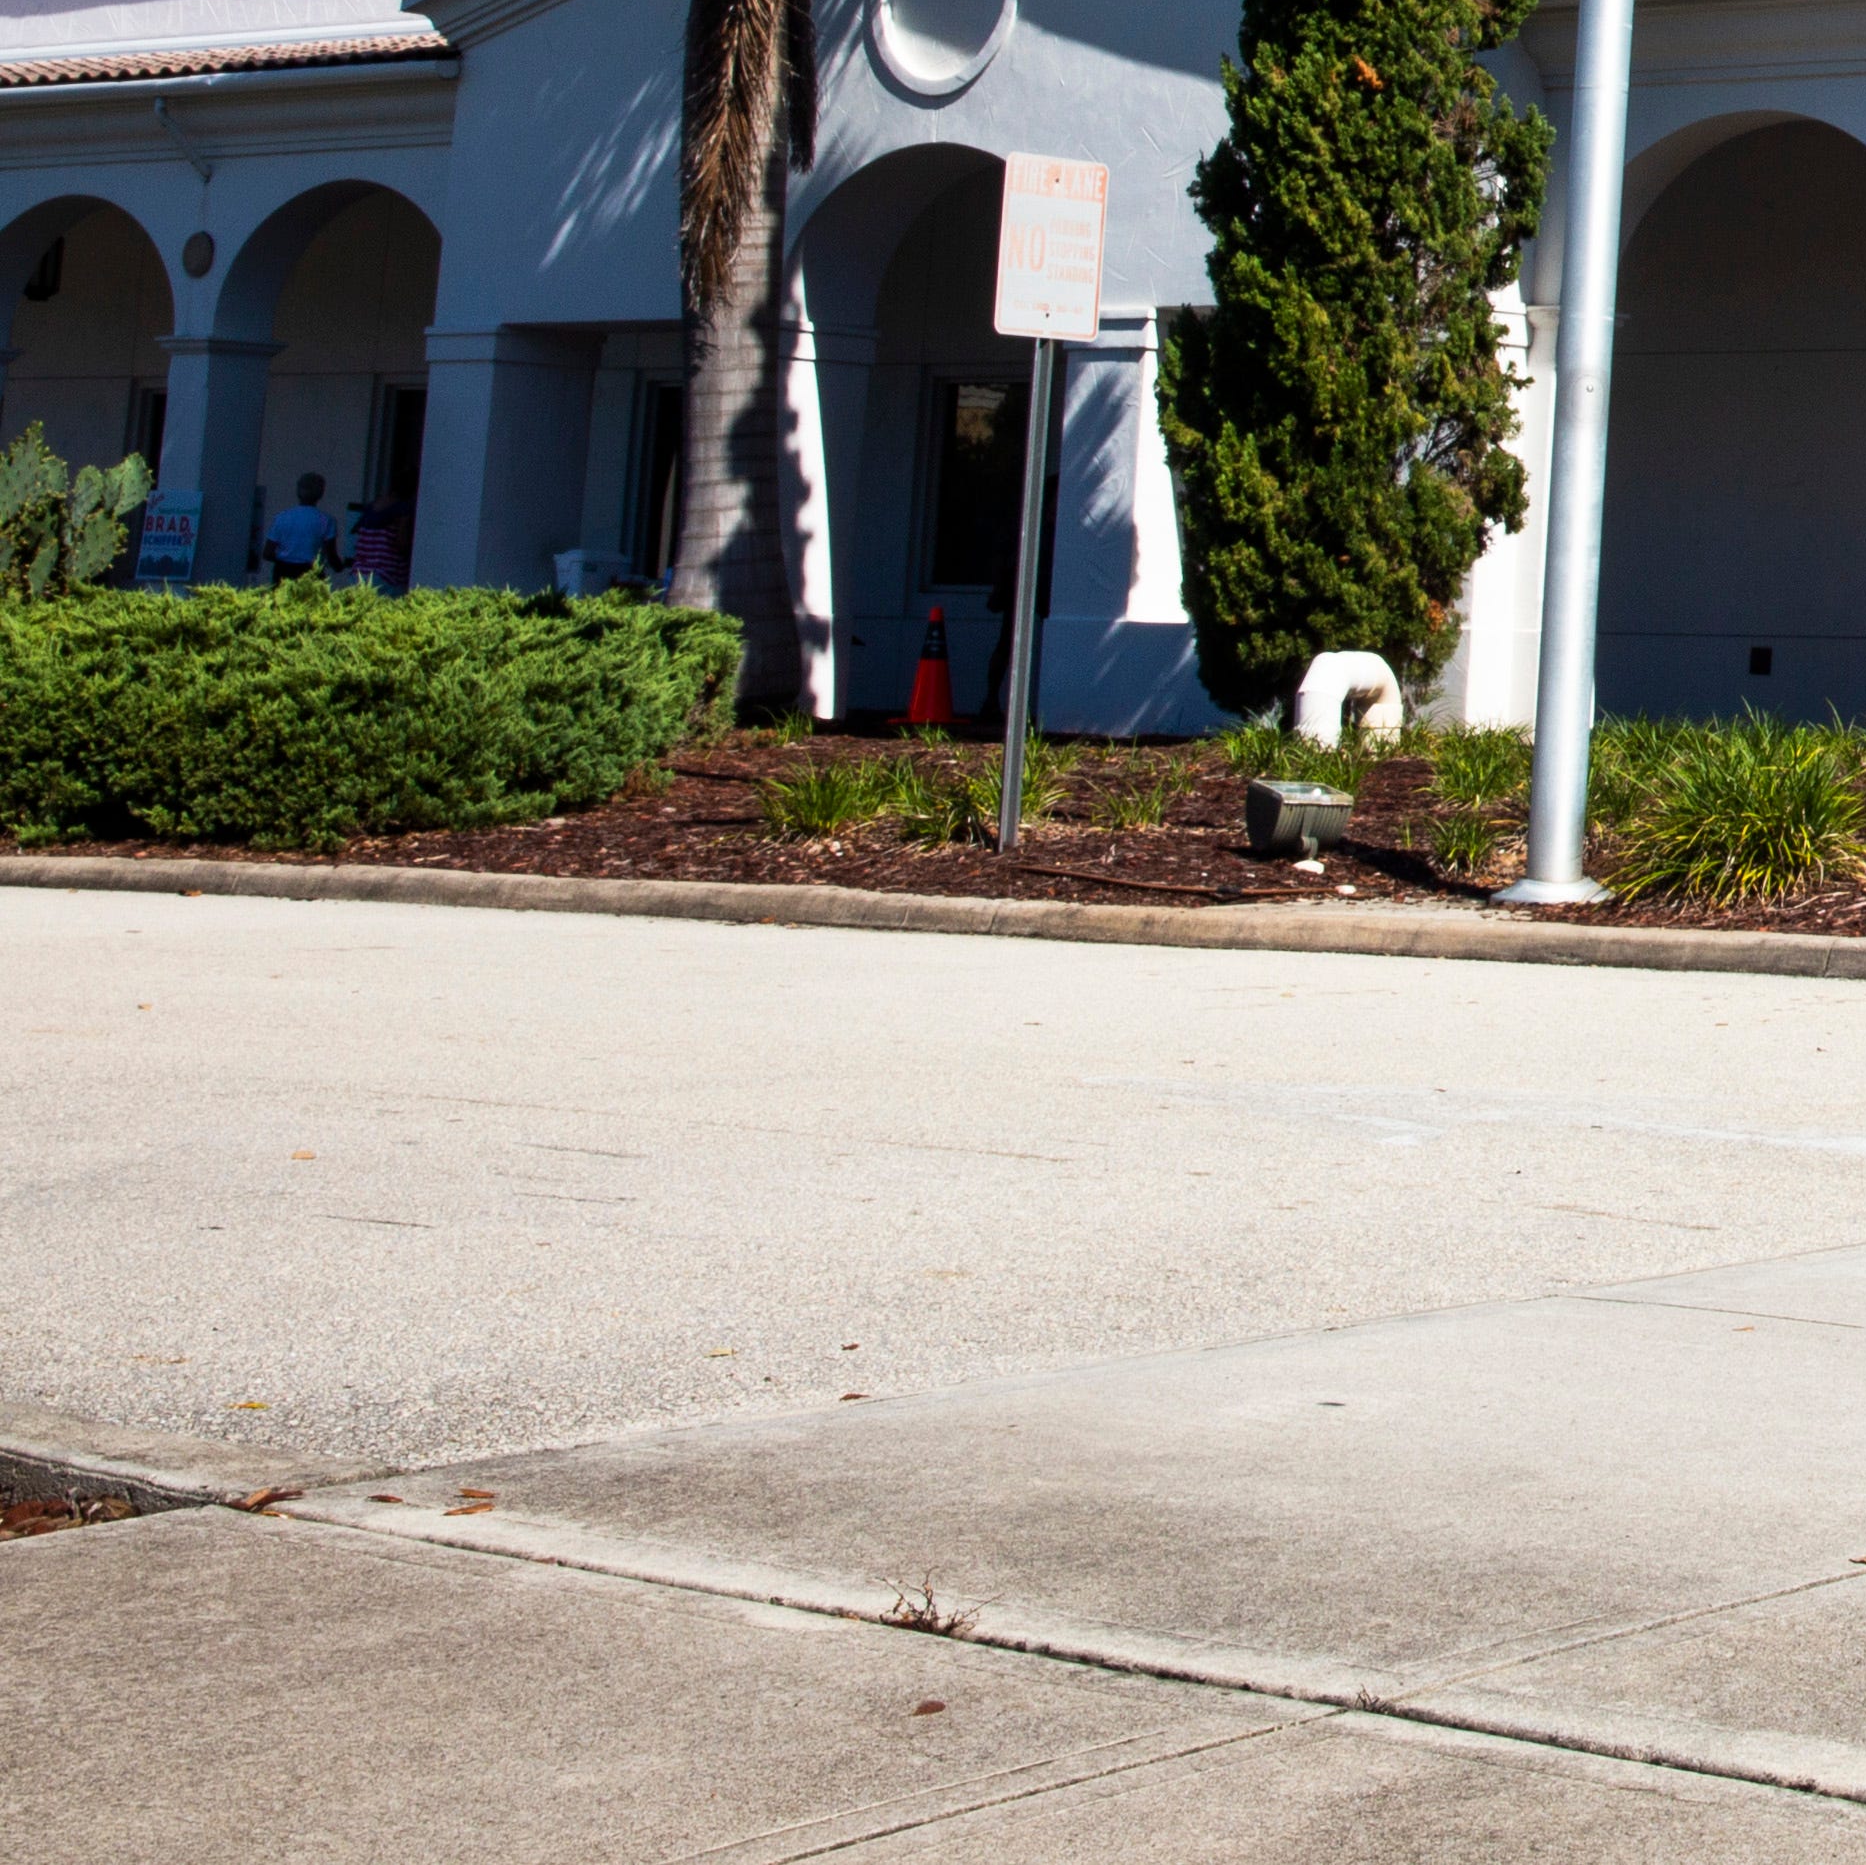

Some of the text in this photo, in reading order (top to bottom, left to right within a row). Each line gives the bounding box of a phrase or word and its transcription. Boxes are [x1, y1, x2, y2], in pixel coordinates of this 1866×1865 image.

[1012, 161, 1104, 199] FIRE LANE
[1008, 221, 1047, 272] NO
[1049, 242, 1096, 261] STOPPING
[1047, 264, 1095, 284] STANDING
[146, 516, 190, 532] BRAD
